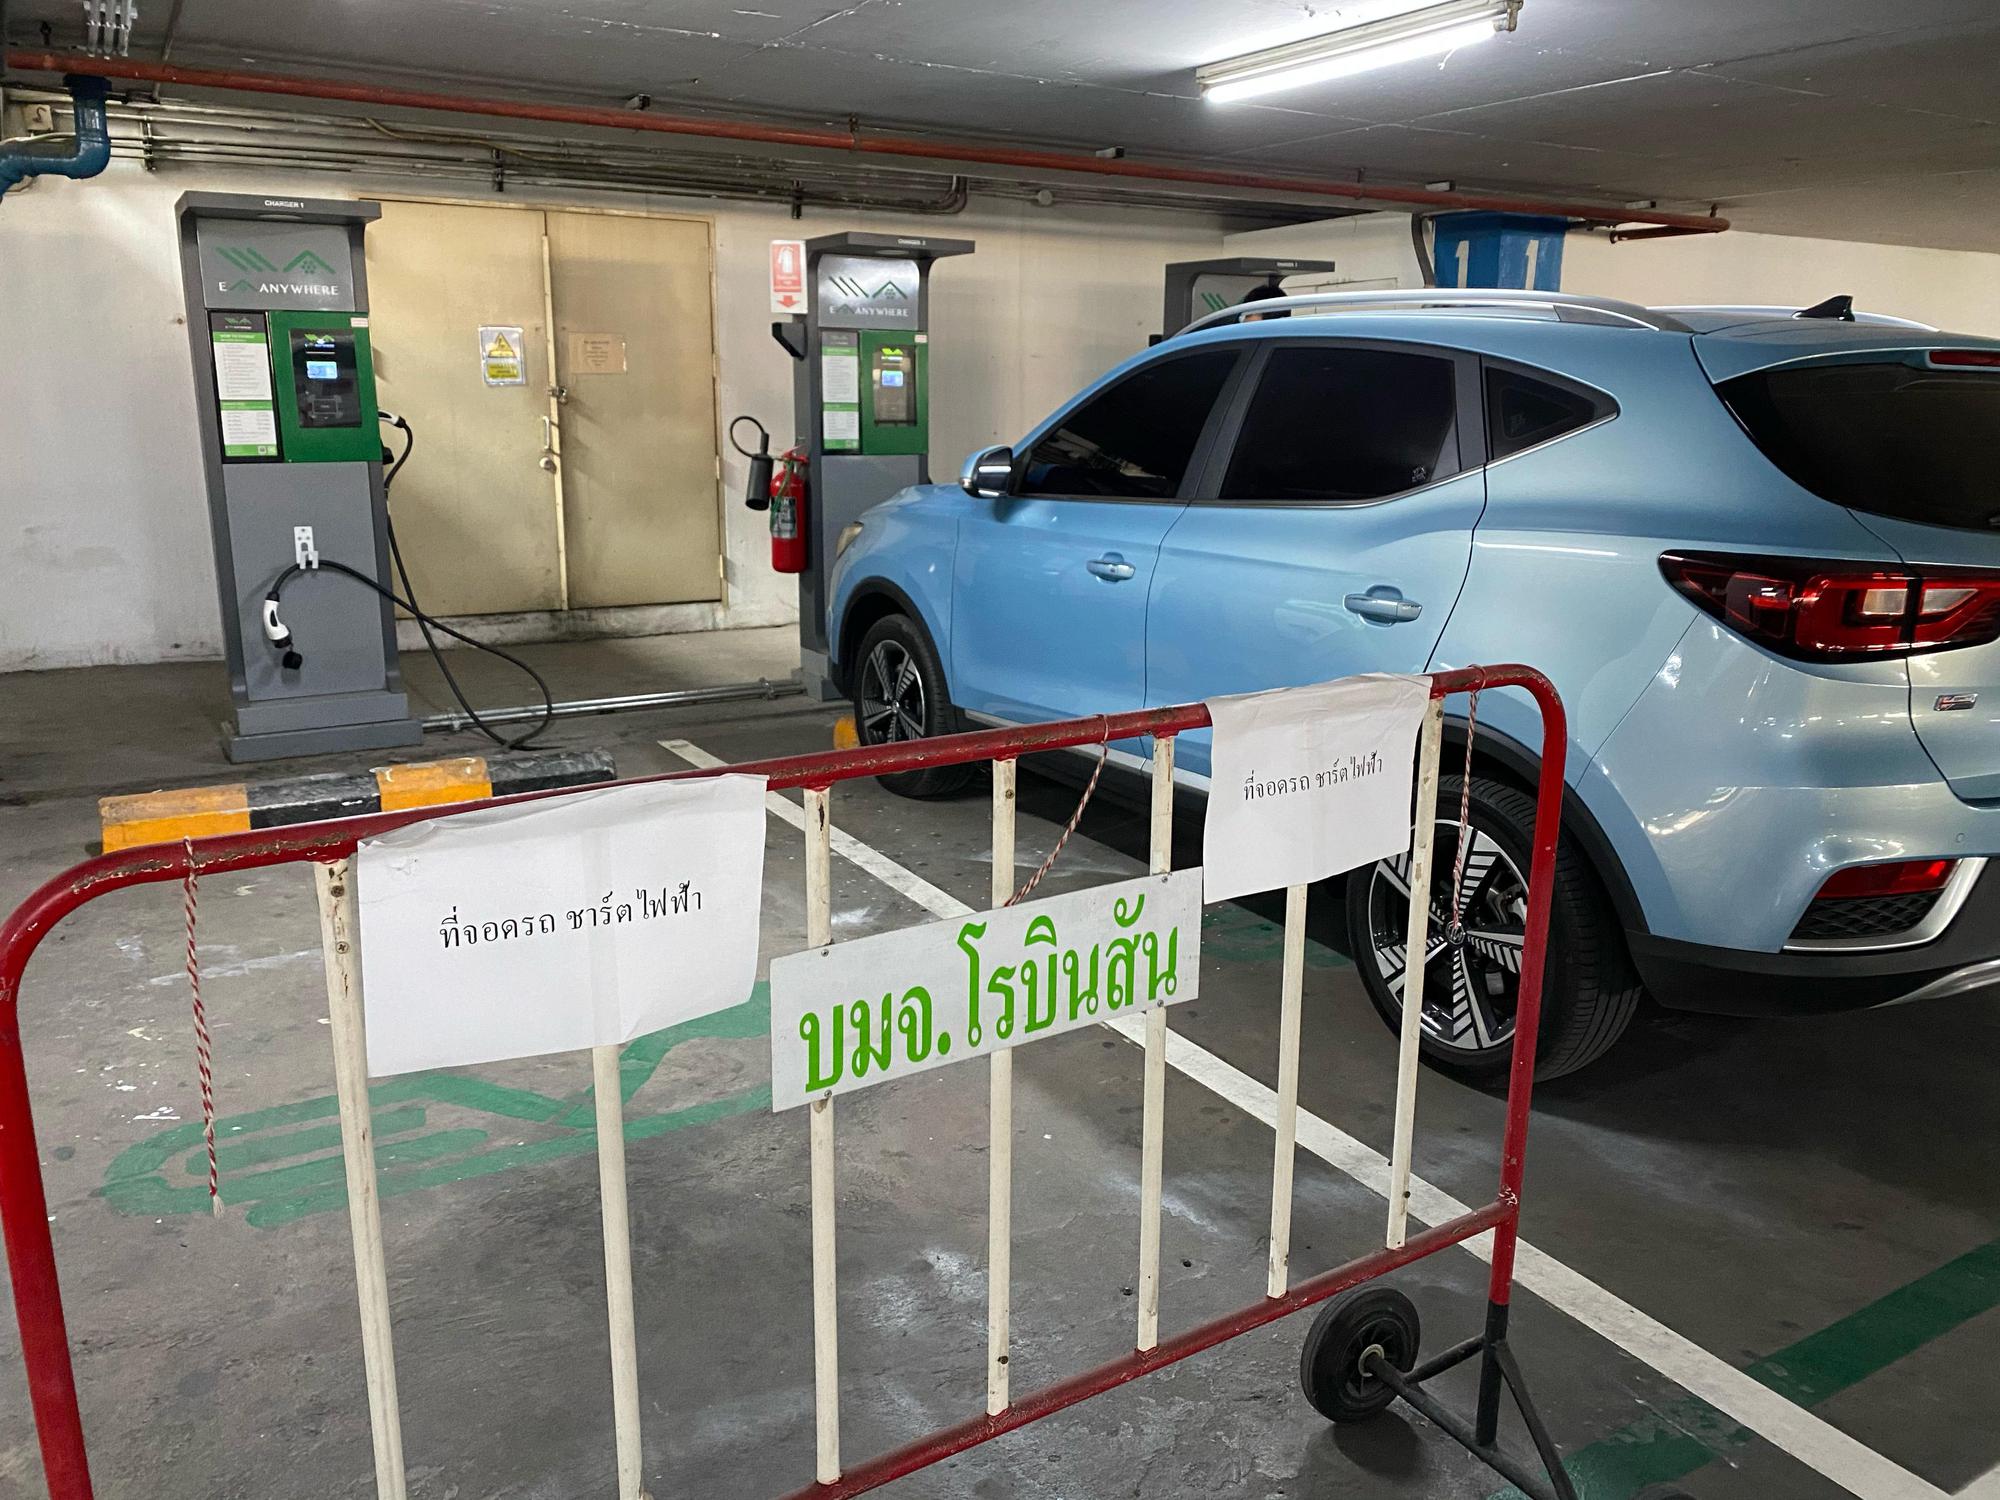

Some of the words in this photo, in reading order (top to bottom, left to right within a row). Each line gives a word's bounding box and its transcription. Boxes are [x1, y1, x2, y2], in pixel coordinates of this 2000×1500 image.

[1455, 239, 1470, 289] 1
[1525, 239, 1540, 290] 1
[259, 282, 339, 296] ANYWHERE
[854, 306, 909, 318] ANYWHERE
[1243, 769, 1310, 801] ที่จอดรถ
[439, 905, 555, 949] ที่จอดรถ
